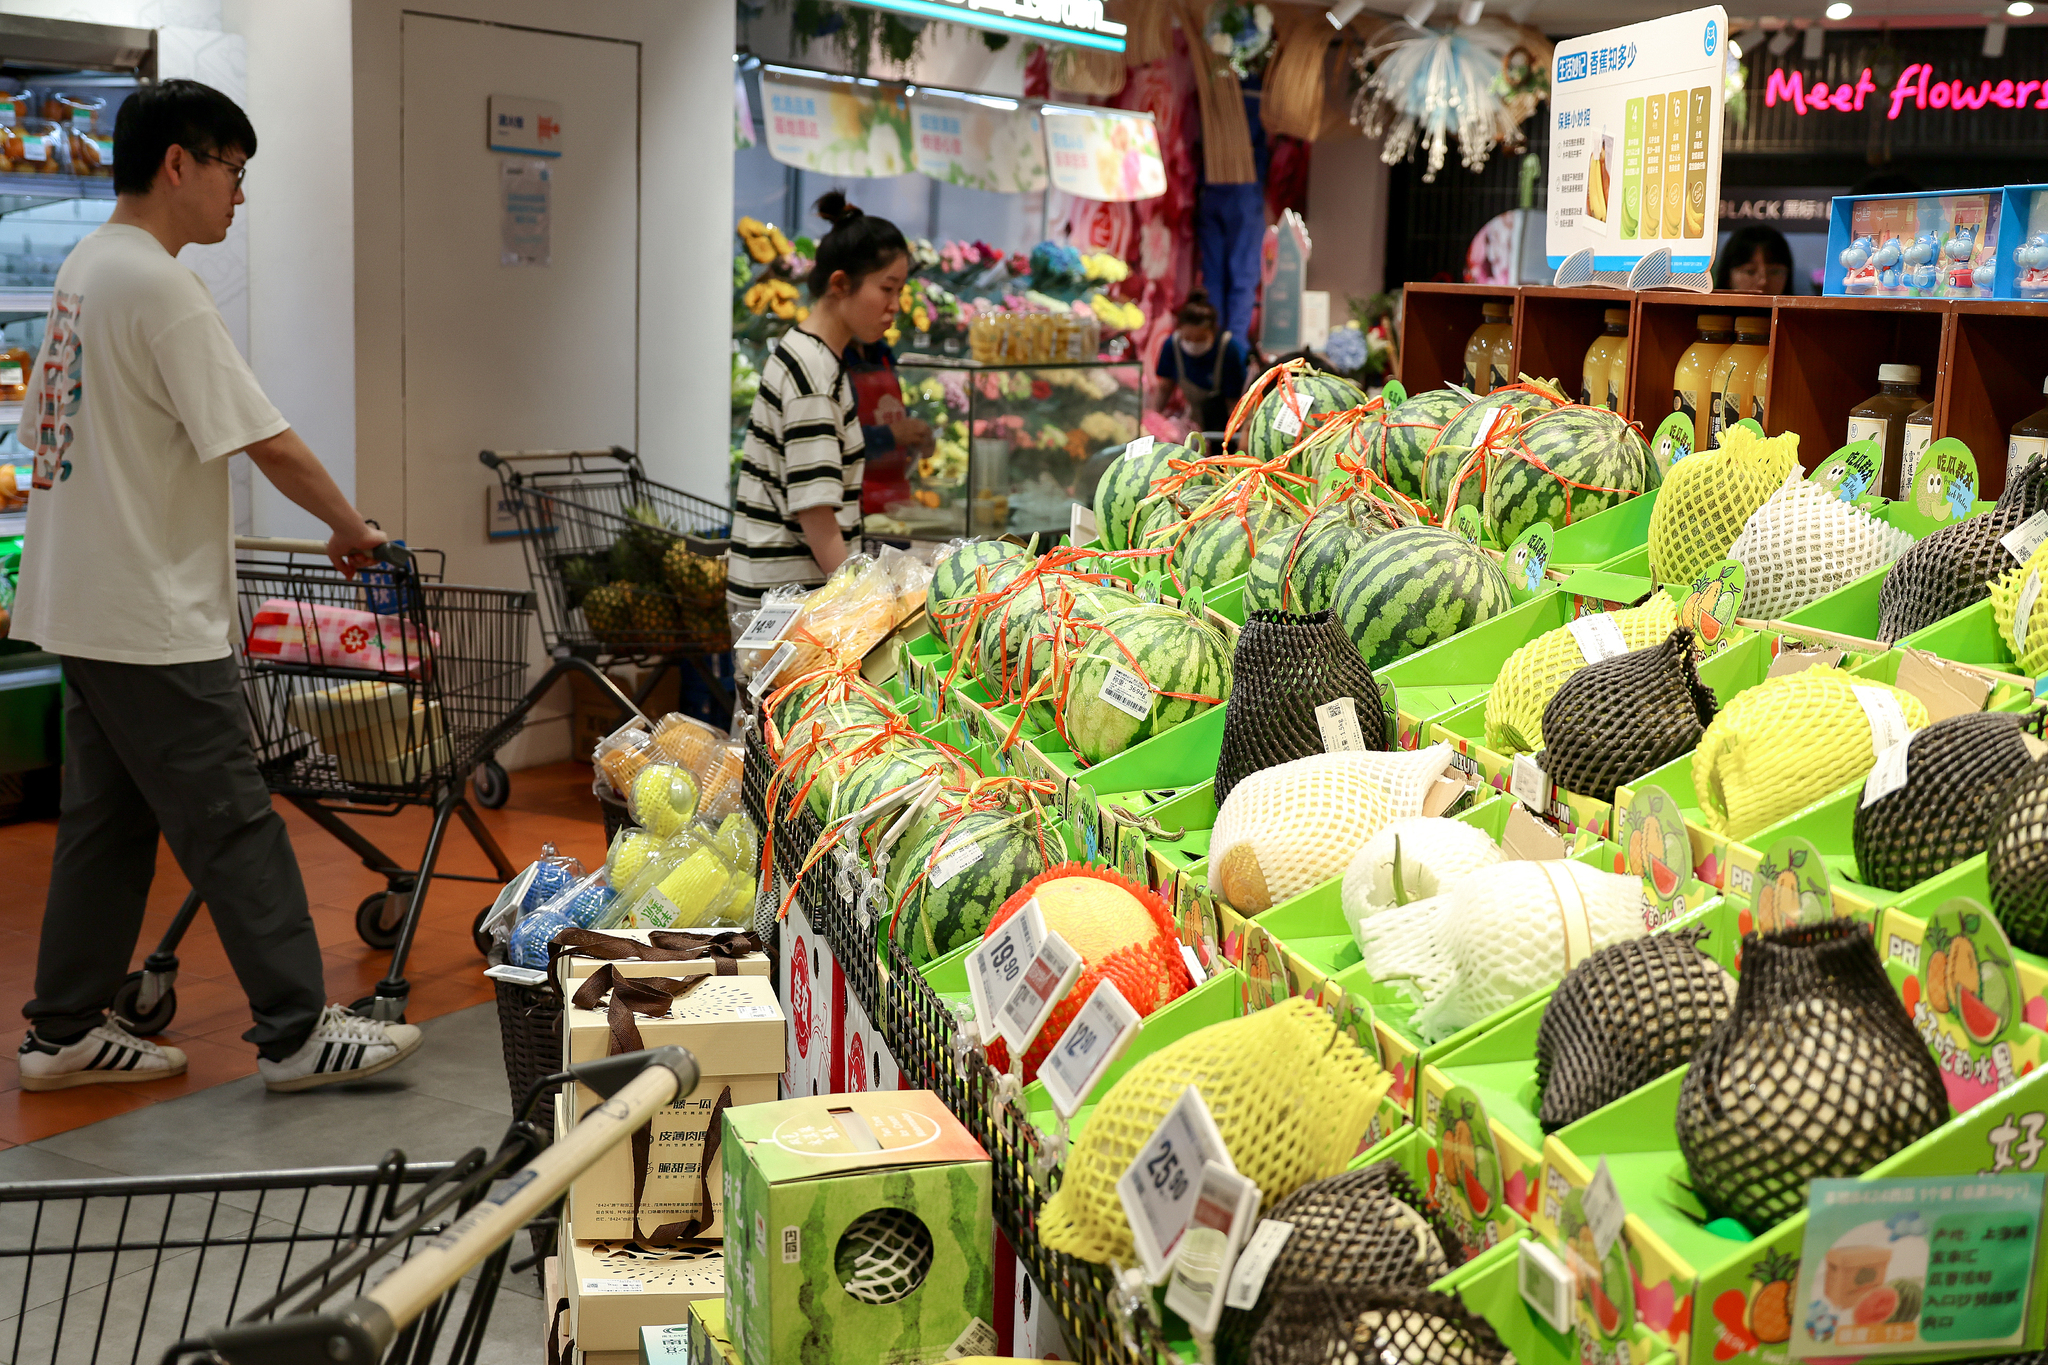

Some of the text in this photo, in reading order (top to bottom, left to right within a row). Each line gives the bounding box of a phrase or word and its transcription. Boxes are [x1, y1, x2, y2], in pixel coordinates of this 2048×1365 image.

[1590, 41, 1637, 76] 香蕉知多少
[1765, 63, 2048, 120] Meet flowers
[1558, 108, 1591, 131] 保鲜小妙招
[1846, 451, 1875, 484] 吃瓜群众
[1937, 453, 1974, 491] 吃瓜群众
